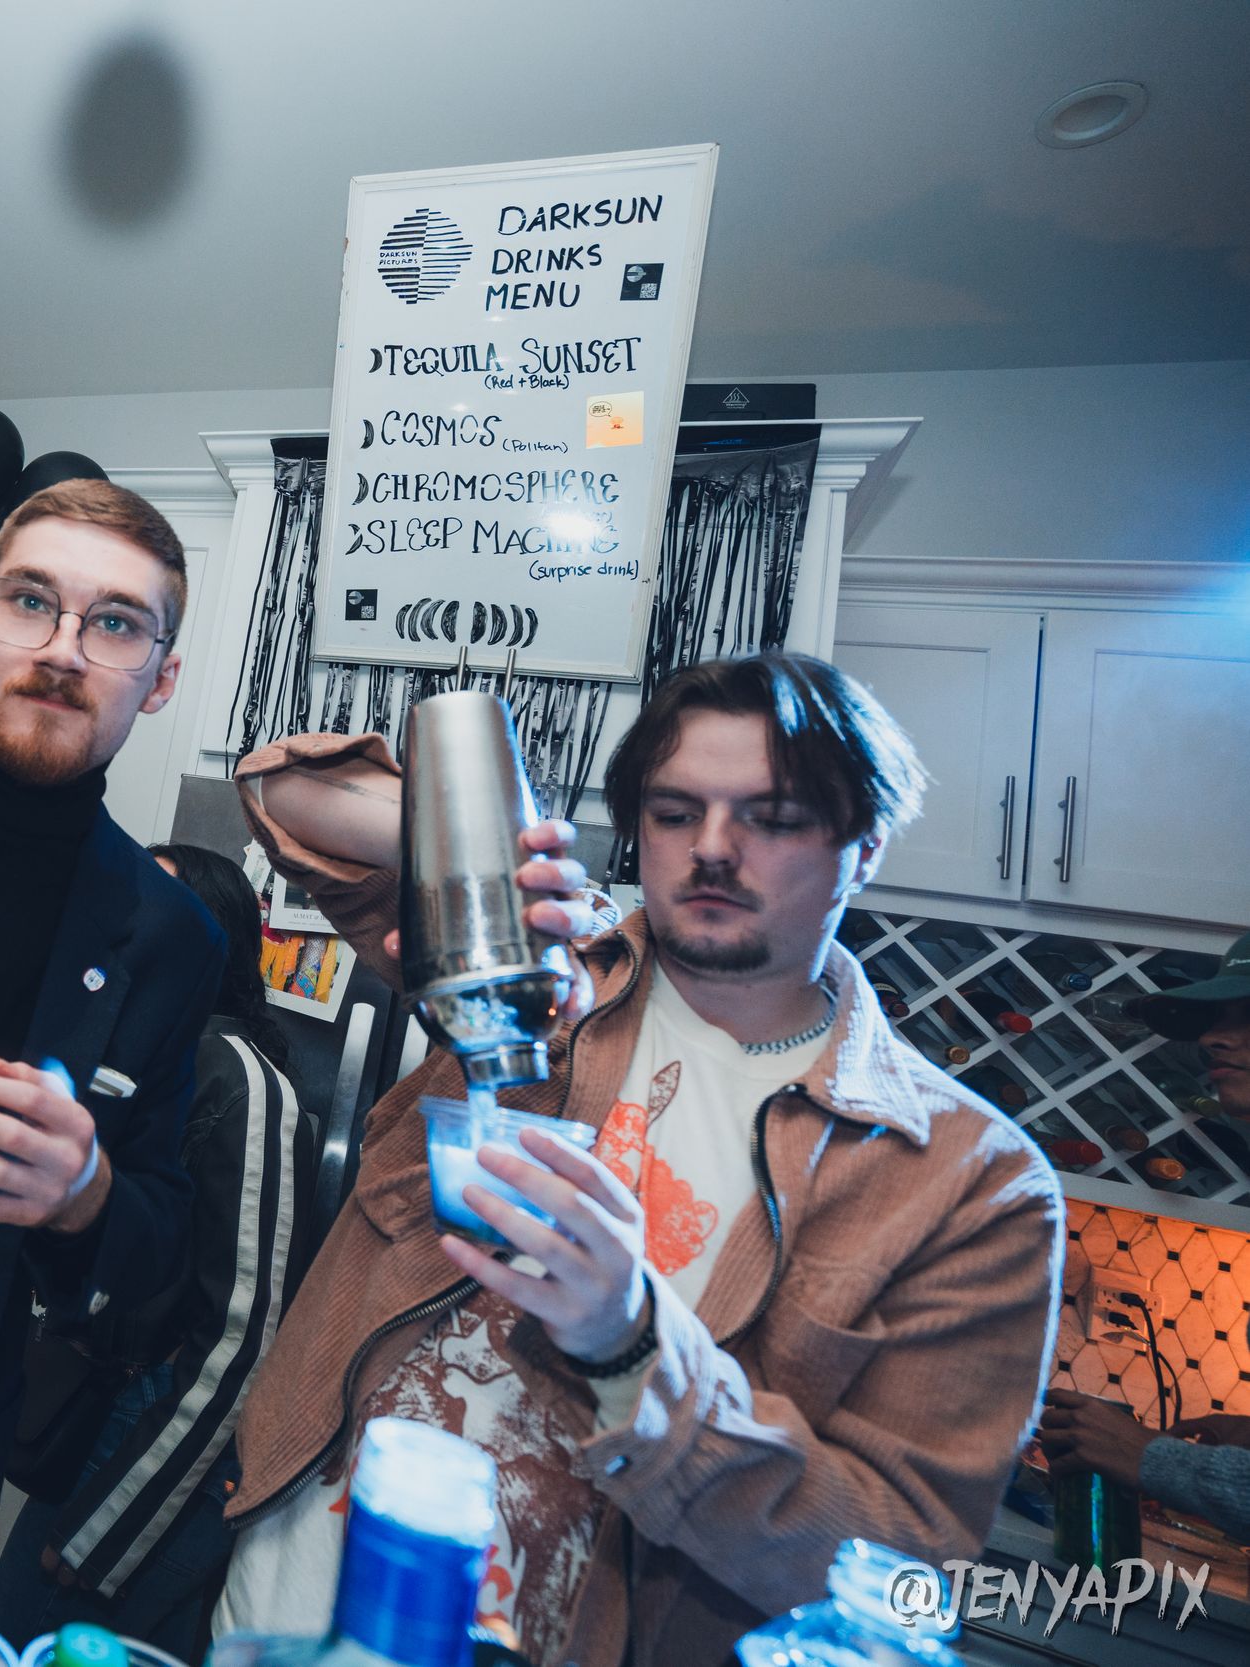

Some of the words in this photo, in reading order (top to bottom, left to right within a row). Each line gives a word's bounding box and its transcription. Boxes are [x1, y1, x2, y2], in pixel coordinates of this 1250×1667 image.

[497, 194, 664, 236] DARKSUN
[378, 258, 418, 266] PICTURES
[491, 243, 603, 276] DRINKS
[485, 280, 581, 312] MENU
[383, 342, 504, 377] TEQUILA
[518, 337, 642, 375] SUNSET
[483, 374, 514, 390] (Red
[380, 410, 503, 447] COSMOS
[502, 438, 569, 454] (Politan)
[372, 469, 620, 505] CHROMOSPHERE
[361, 516, 463, 555] SLEEP
[528, 559, 592, 583] (surprise
[597, 559, 639, 581] drink)
